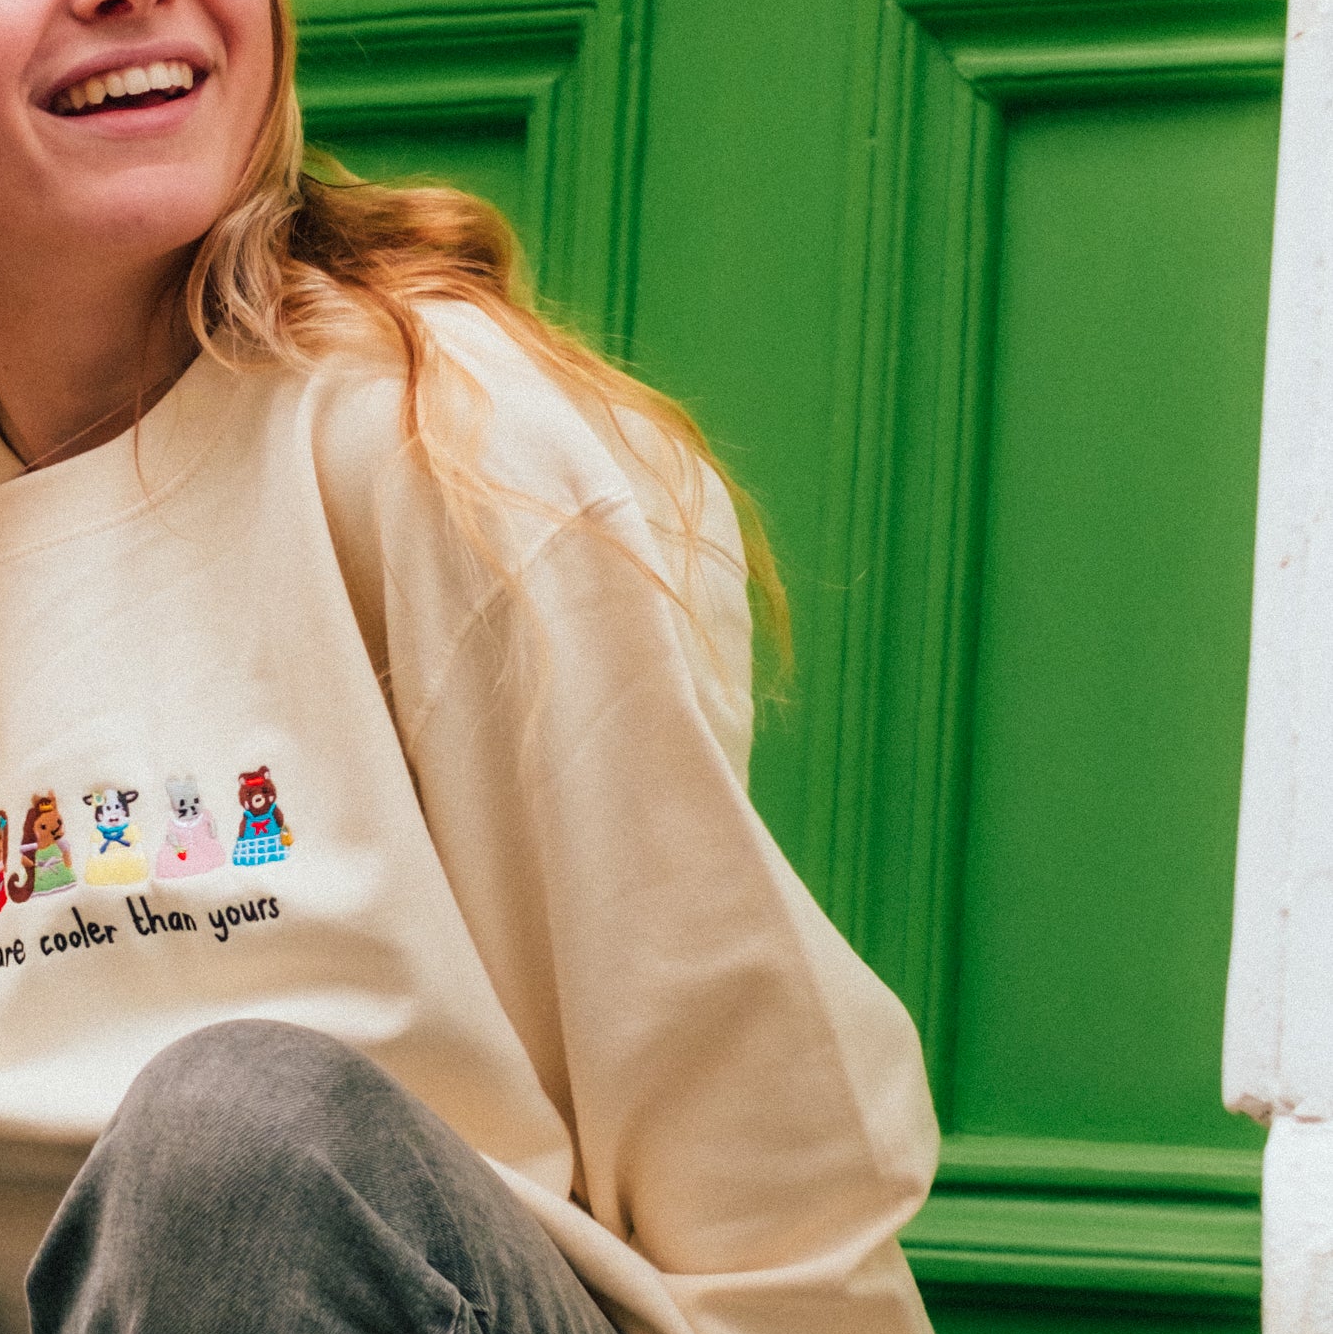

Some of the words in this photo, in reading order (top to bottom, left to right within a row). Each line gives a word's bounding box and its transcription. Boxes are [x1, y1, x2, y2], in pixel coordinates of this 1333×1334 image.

[39, 906, 118, 957] cooler
[125, 895, 198, 937] than
[207, 896, 280, 943] yours
